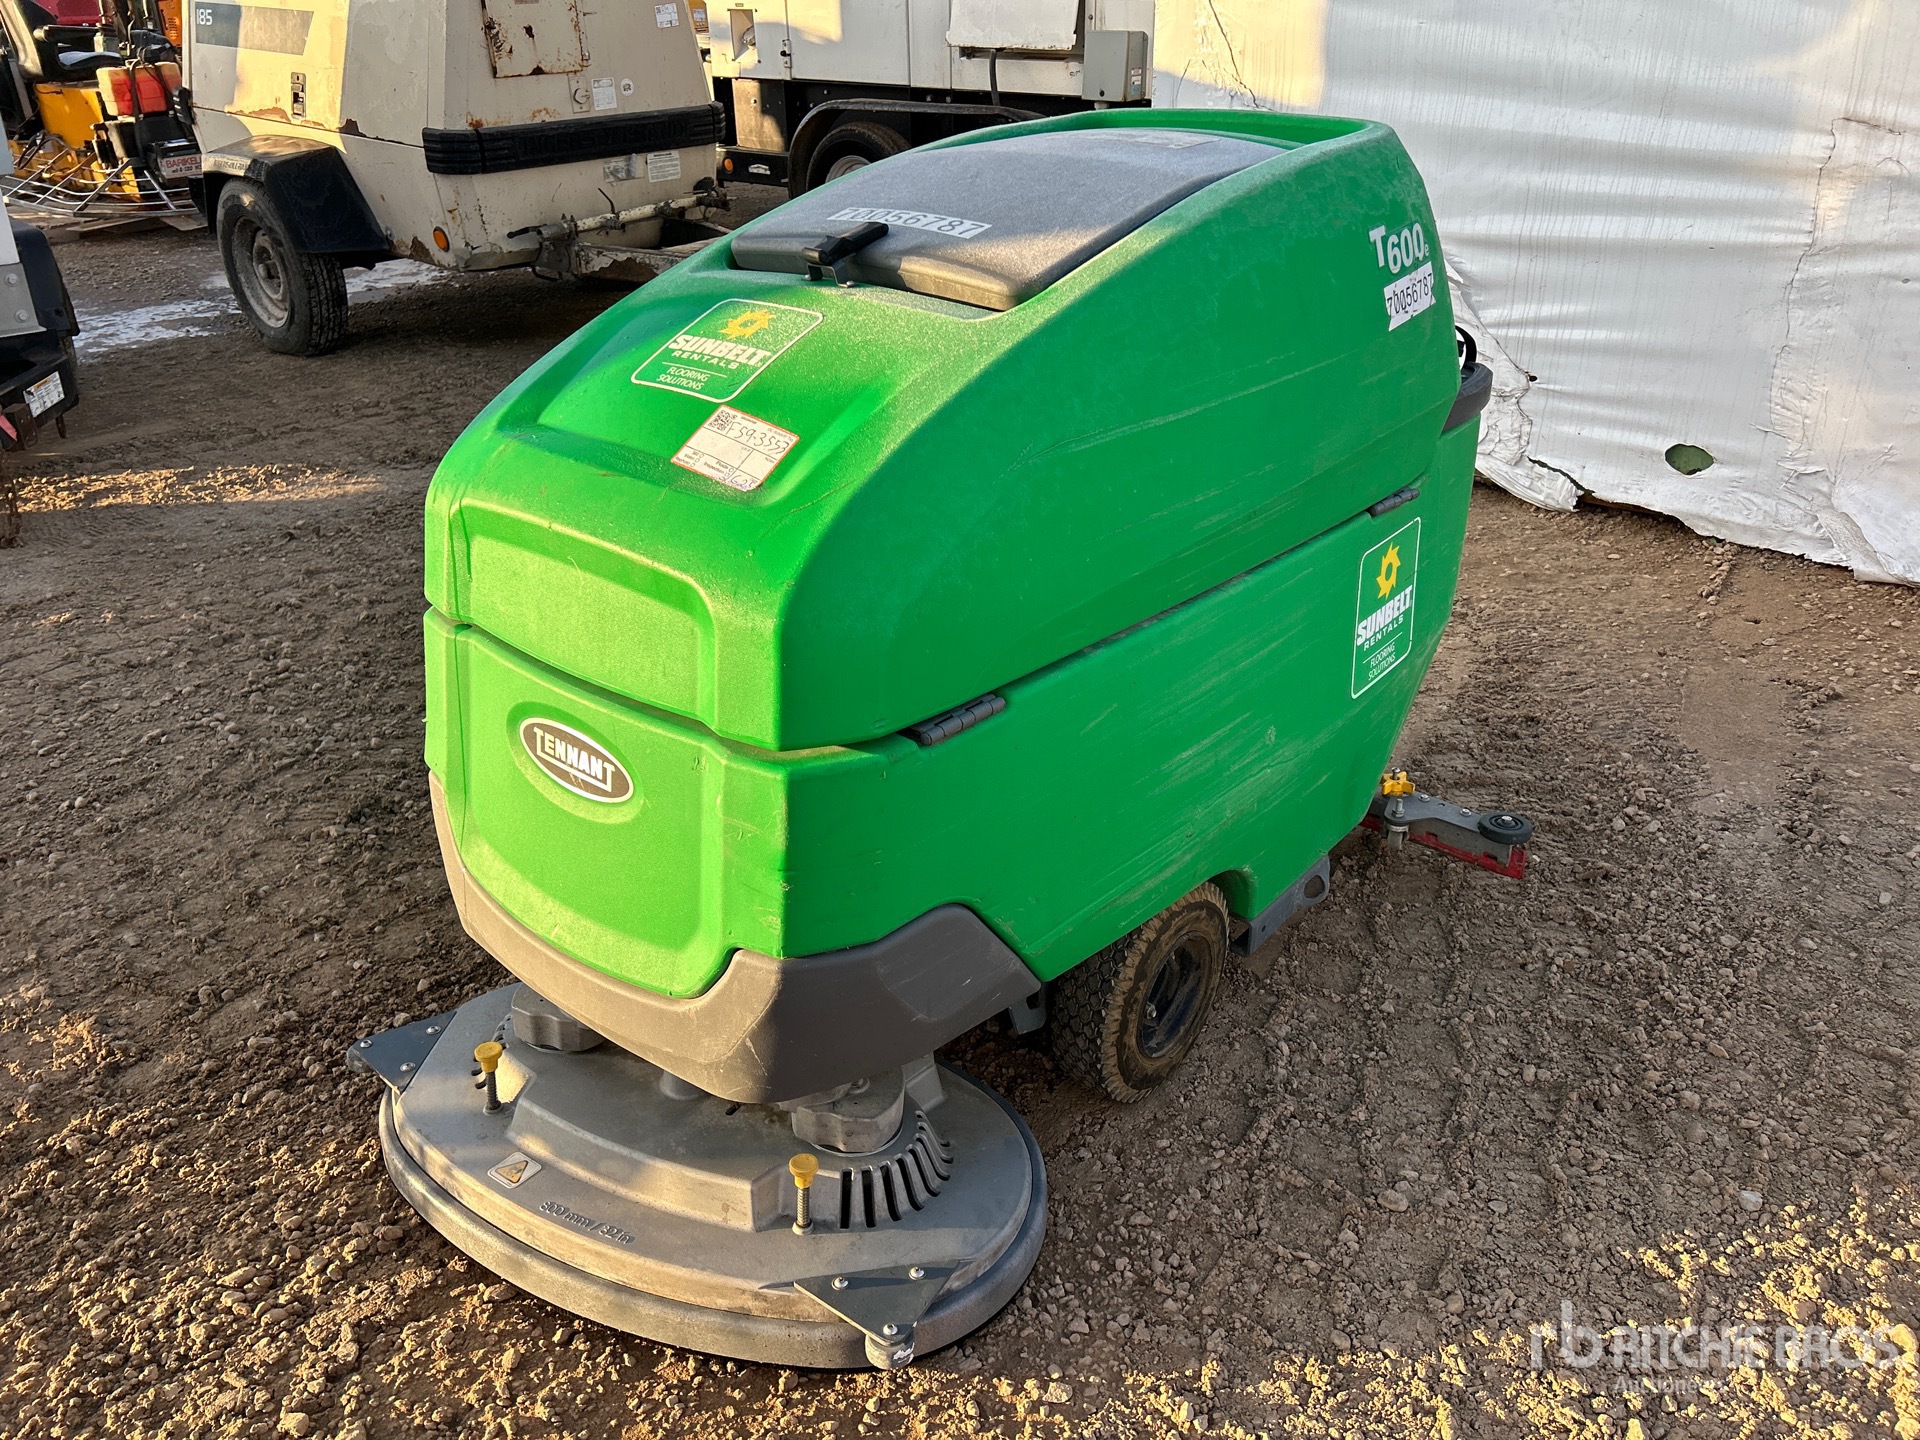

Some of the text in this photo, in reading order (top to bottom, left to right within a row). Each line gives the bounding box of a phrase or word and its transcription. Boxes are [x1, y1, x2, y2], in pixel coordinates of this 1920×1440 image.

[196, 8, 213, 26] 185
[836, 208, 985, 236] 70056787
[1387, 272, 1433, 315] 70056787
[668, 335, 772, 367] SUNBELT
[672, 351, 741, 370] RENTALS
[656, 374, 705, 391] SOLUTIONS
[666, 367, 711, 382] FLOORING
[1356, 584, 1413, 647] SUNBELT
[1363, 615, 1405, 652] RENTALS
[1368, 653, 1396, 681] SOLUTIONS
[1369, 642, 1396, 668] FLOORING
[533, 726, 616, 793] TENNANT
[539, 1200, 566, 1217] 800
[564, 1211, 591, 1228] mm
